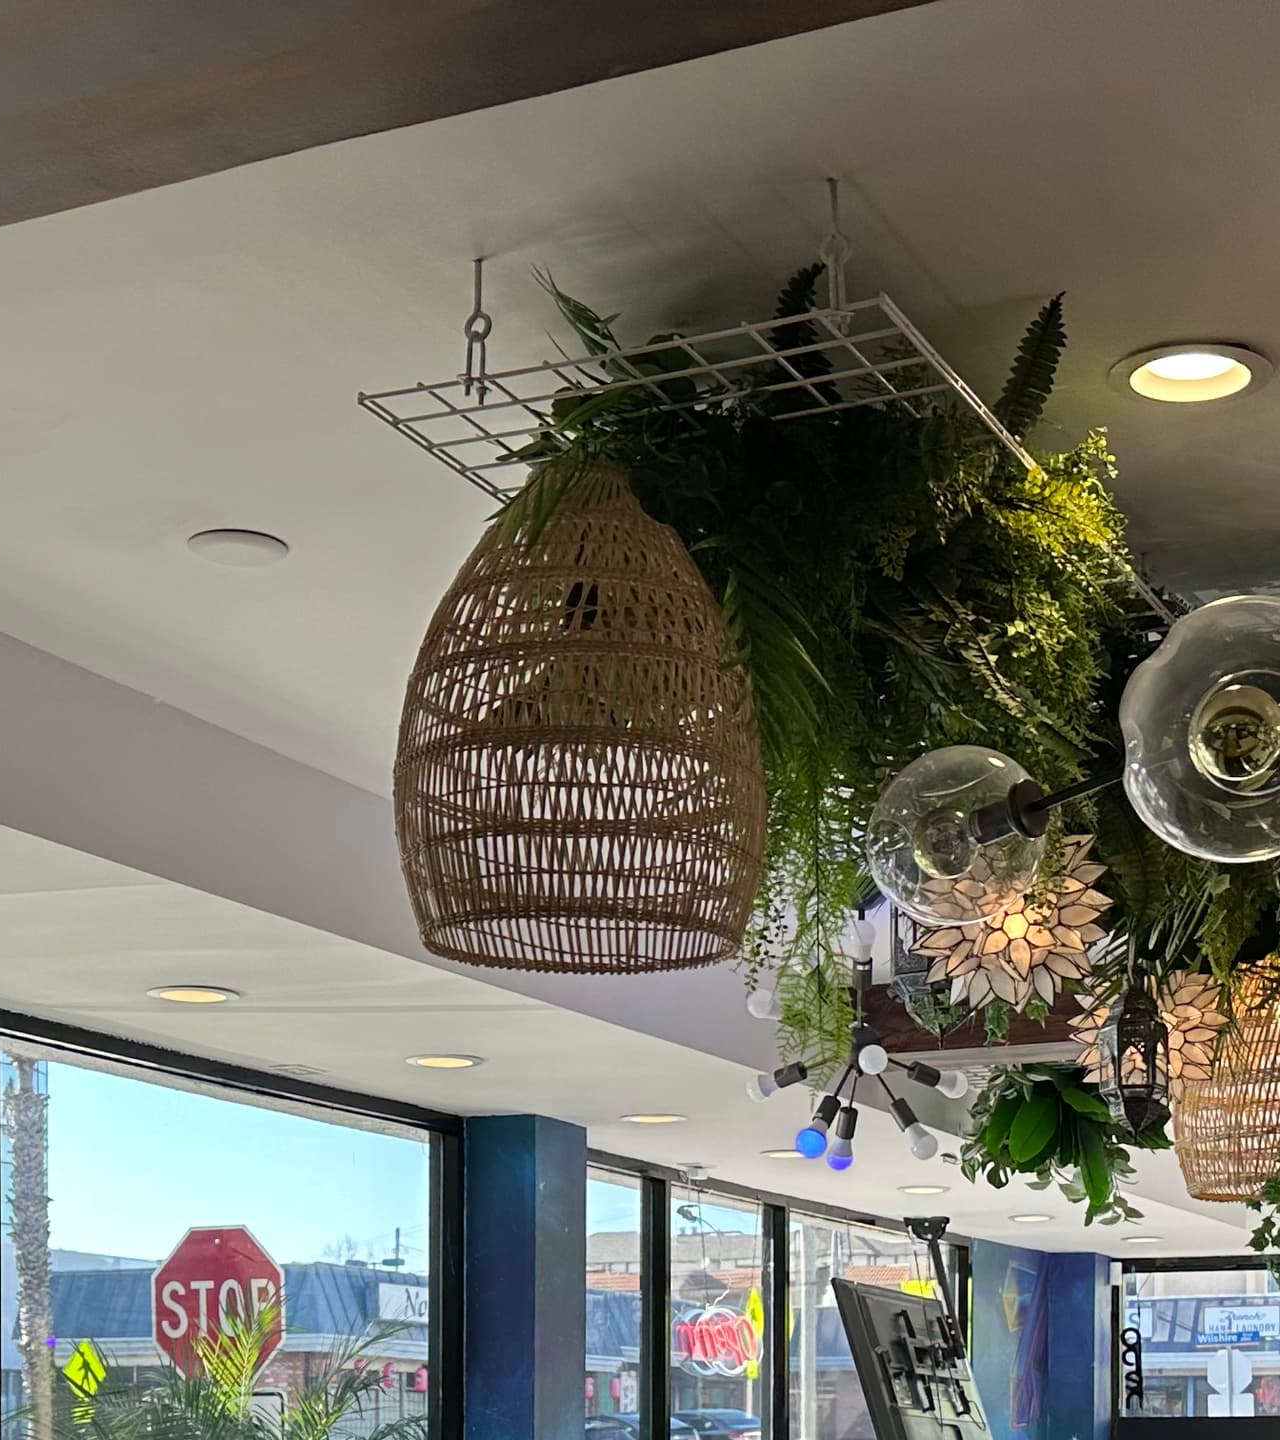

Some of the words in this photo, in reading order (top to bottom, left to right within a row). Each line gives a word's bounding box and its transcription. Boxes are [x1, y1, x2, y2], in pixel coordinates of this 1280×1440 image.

[161, 1279, 277, 1339] STOP
[1236, 1323, 1276, 1332] LAUNDRY
[1197, 1334, 1238, 1343] Wilshire
